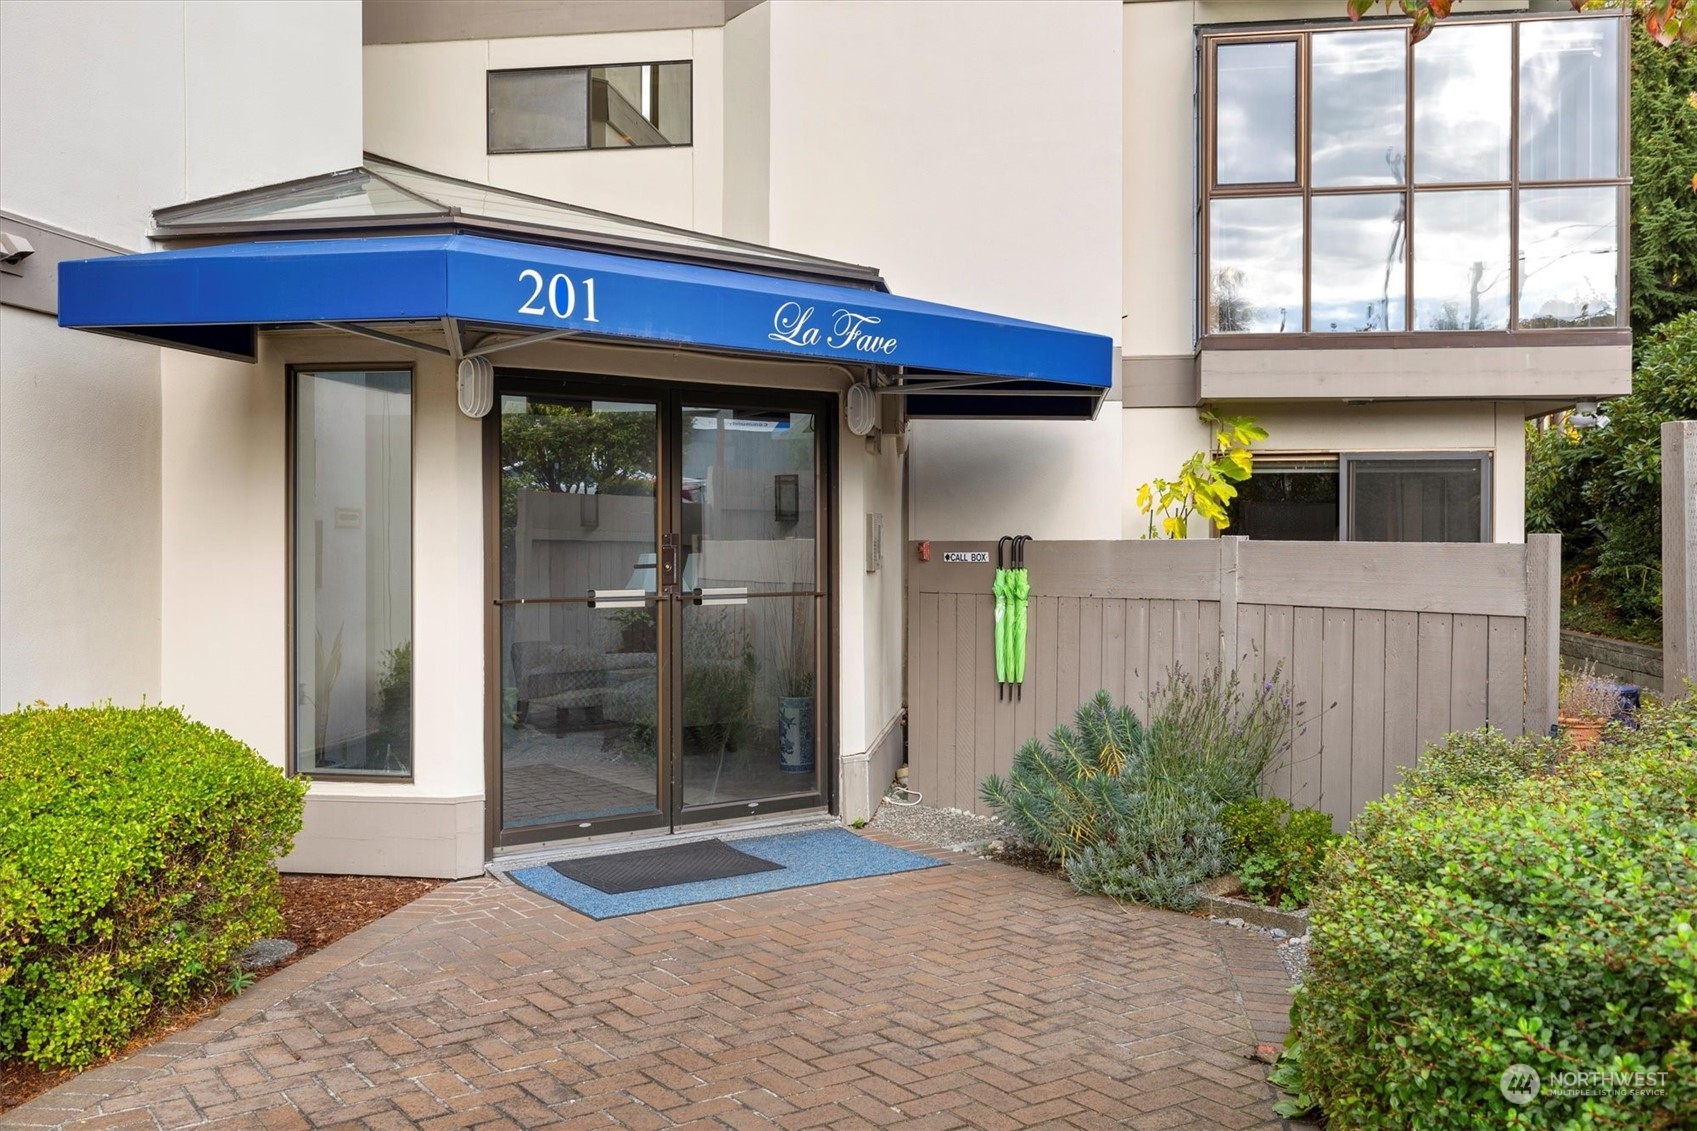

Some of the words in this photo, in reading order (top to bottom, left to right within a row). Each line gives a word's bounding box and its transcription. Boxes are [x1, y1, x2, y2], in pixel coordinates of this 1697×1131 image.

[518, 269, 599, 323] 201
[768, 301, 821, 346] La
[826, 308, 898, 355] Fave
[950, 553, 969, 561] CALL
[971, 553, 986, 561] BOX
